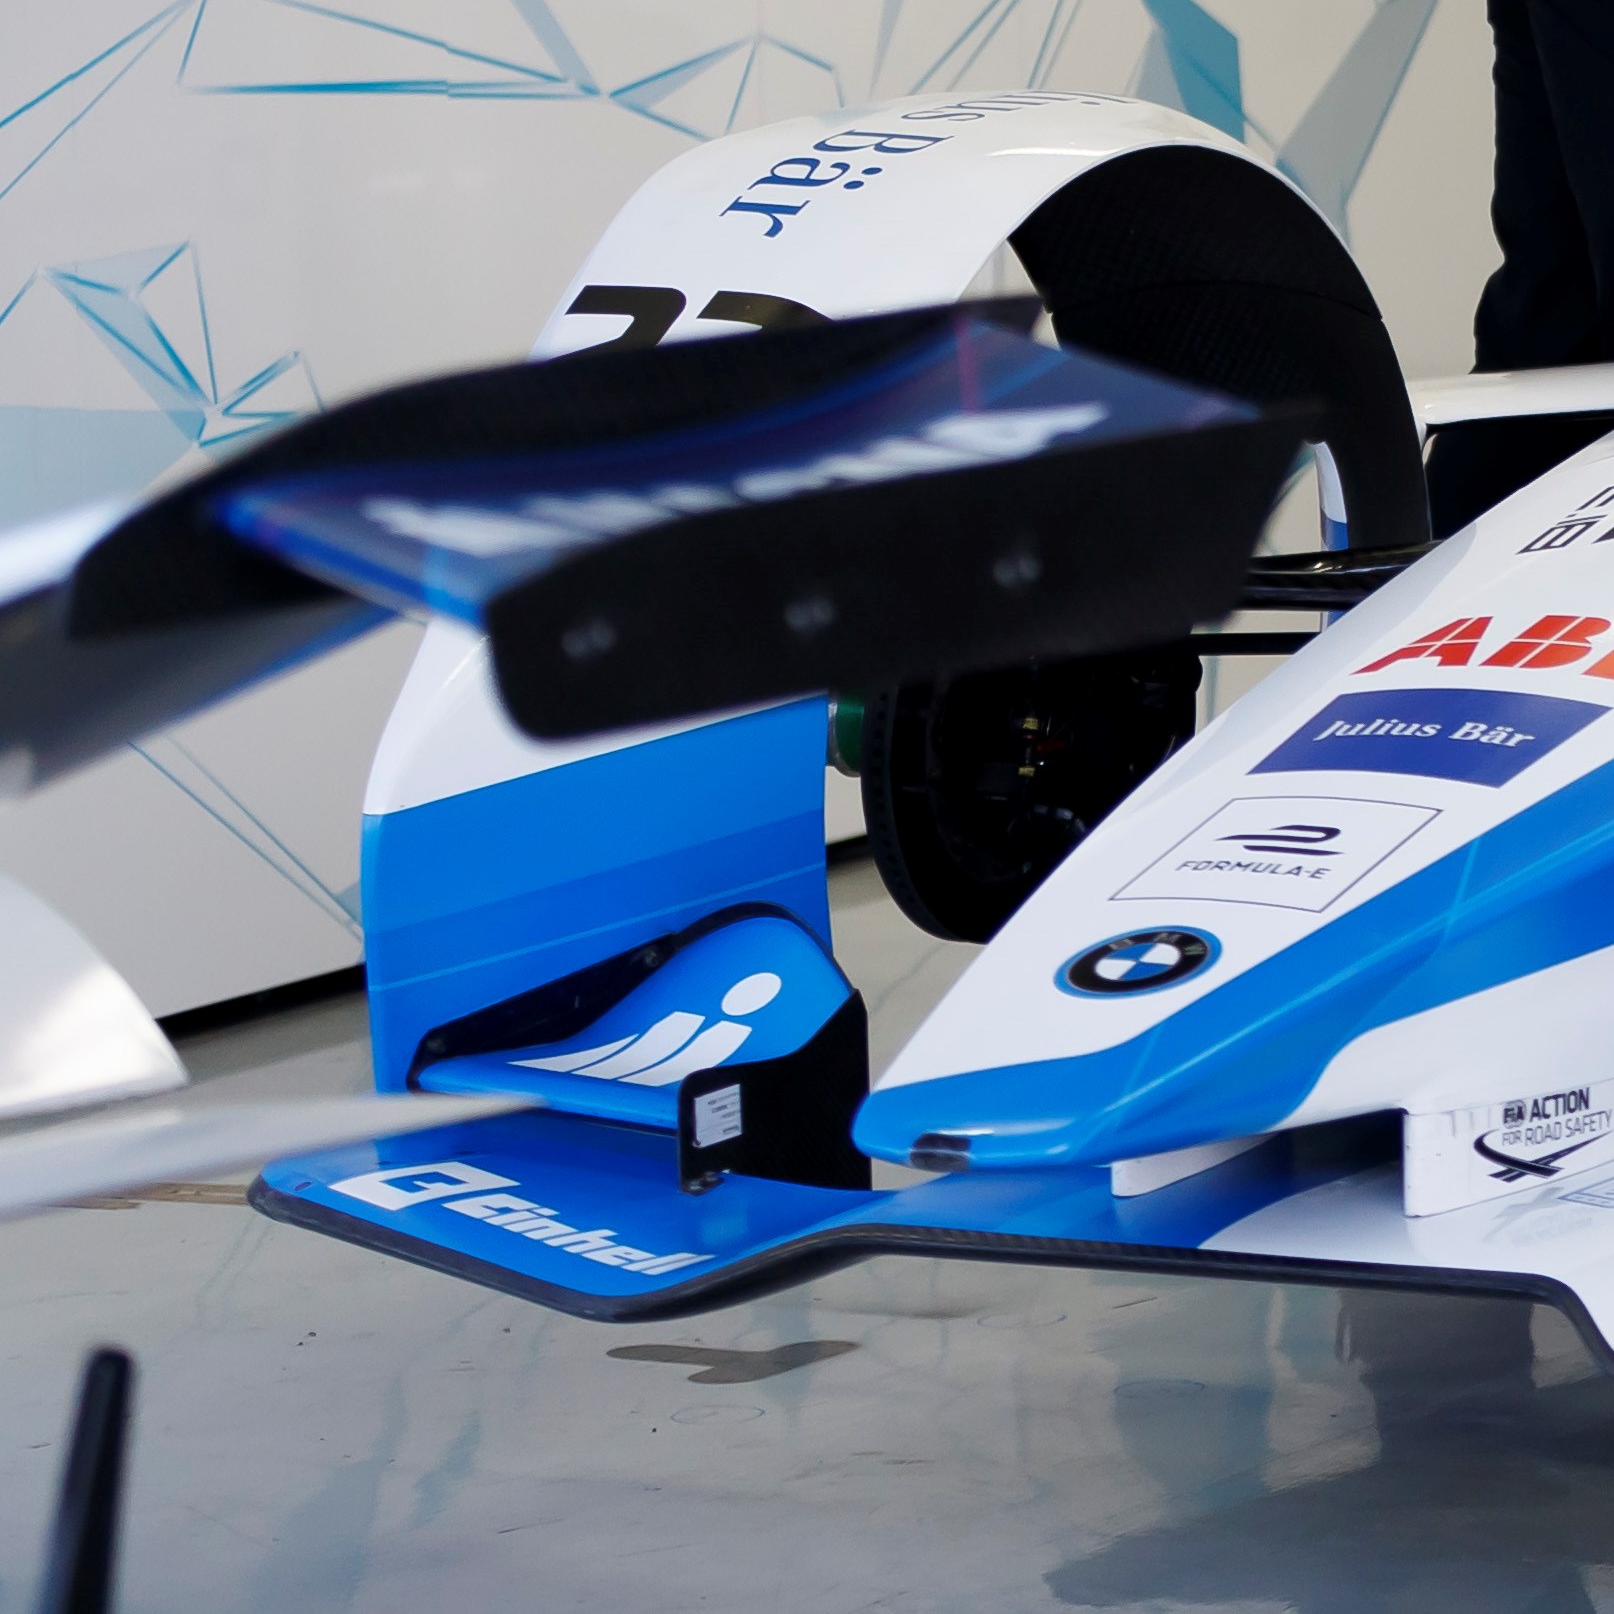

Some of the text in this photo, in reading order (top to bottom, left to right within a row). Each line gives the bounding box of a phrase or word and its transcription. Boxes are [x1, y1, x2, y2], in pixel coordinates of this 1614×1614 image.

[1312, 718, 1536, 748] Julius Bär
[1528, 1086, 1590, 1123] ACTION
[1501, 1108, 1613, 1147] FOR ROAD SAFETY
[441, 1192, 719, 1276] Einhell
